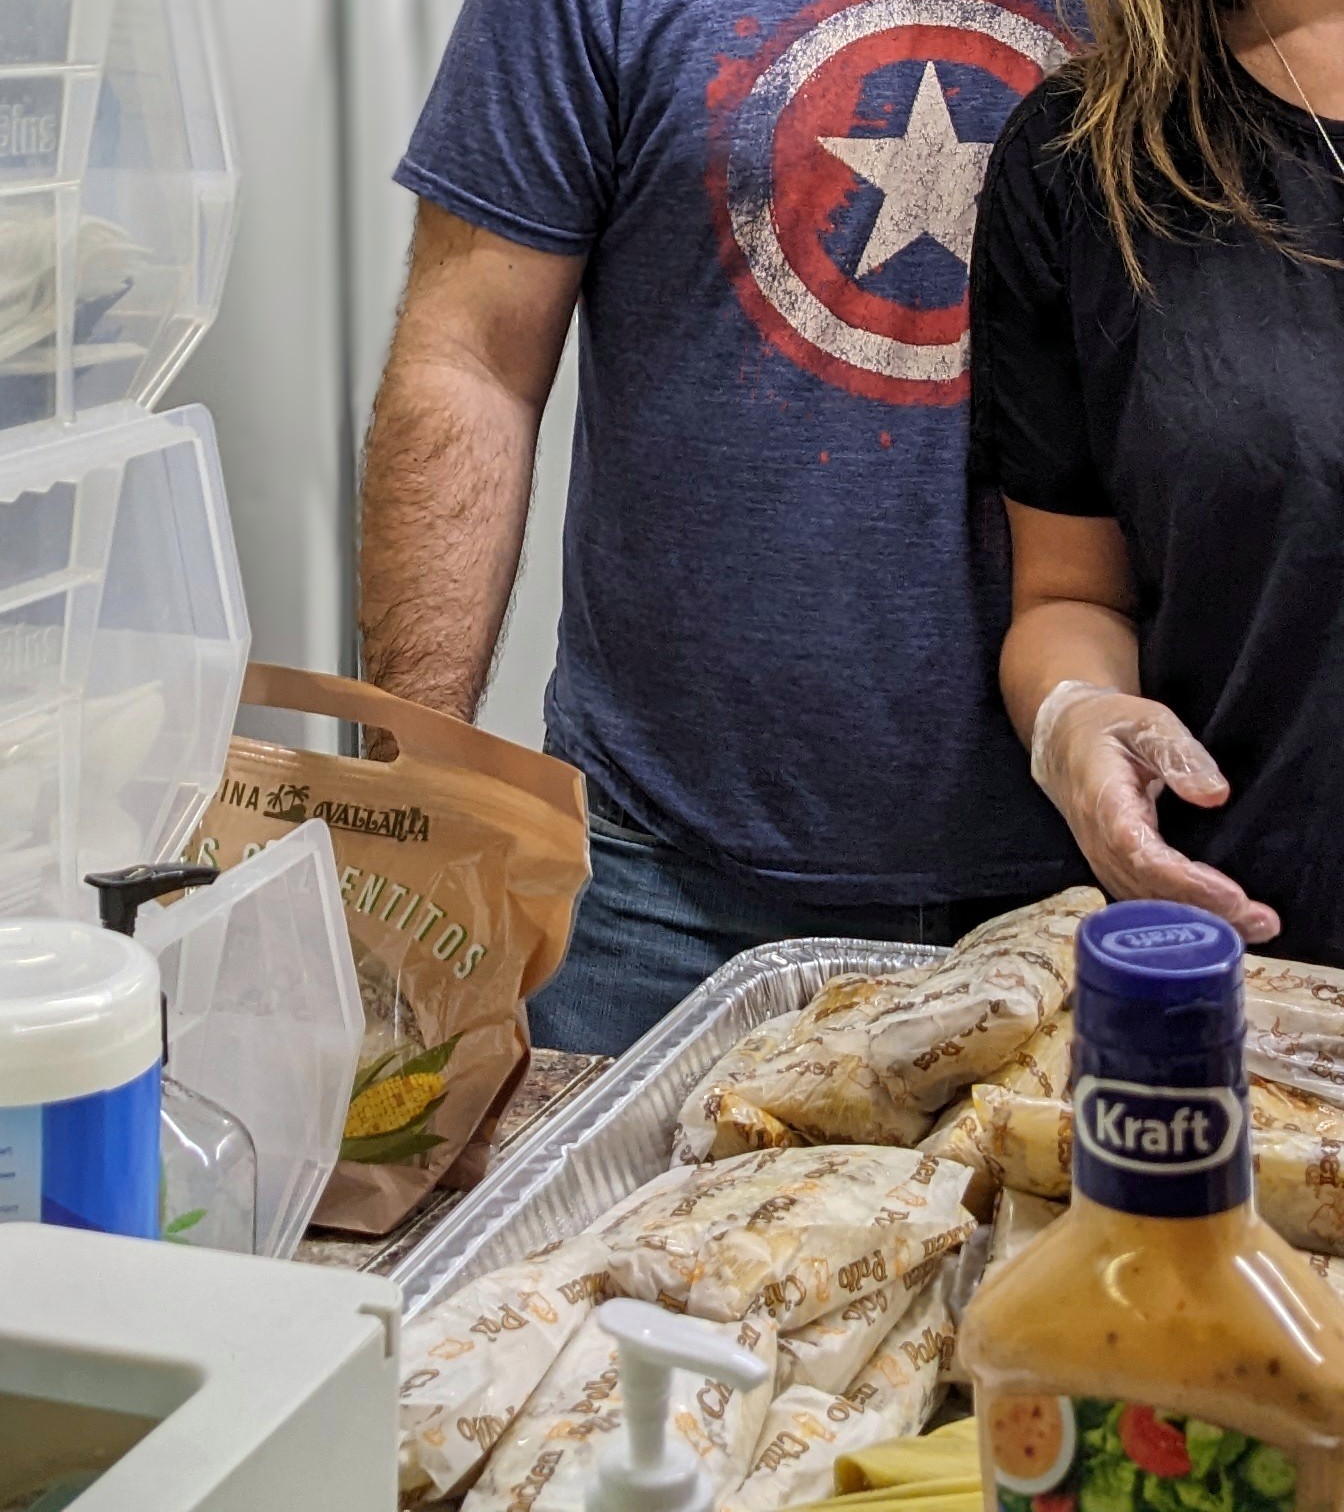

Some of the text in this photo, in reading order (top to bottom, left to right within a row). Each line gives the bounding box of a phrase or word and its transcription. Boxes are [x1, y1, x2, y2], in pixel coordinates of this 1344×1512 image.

[213, 777, 430, 843] INA VALLARTA
[340, 864, 488, 981] ENTITOS
[1094, 1097, 1211, 1156] Kraft
